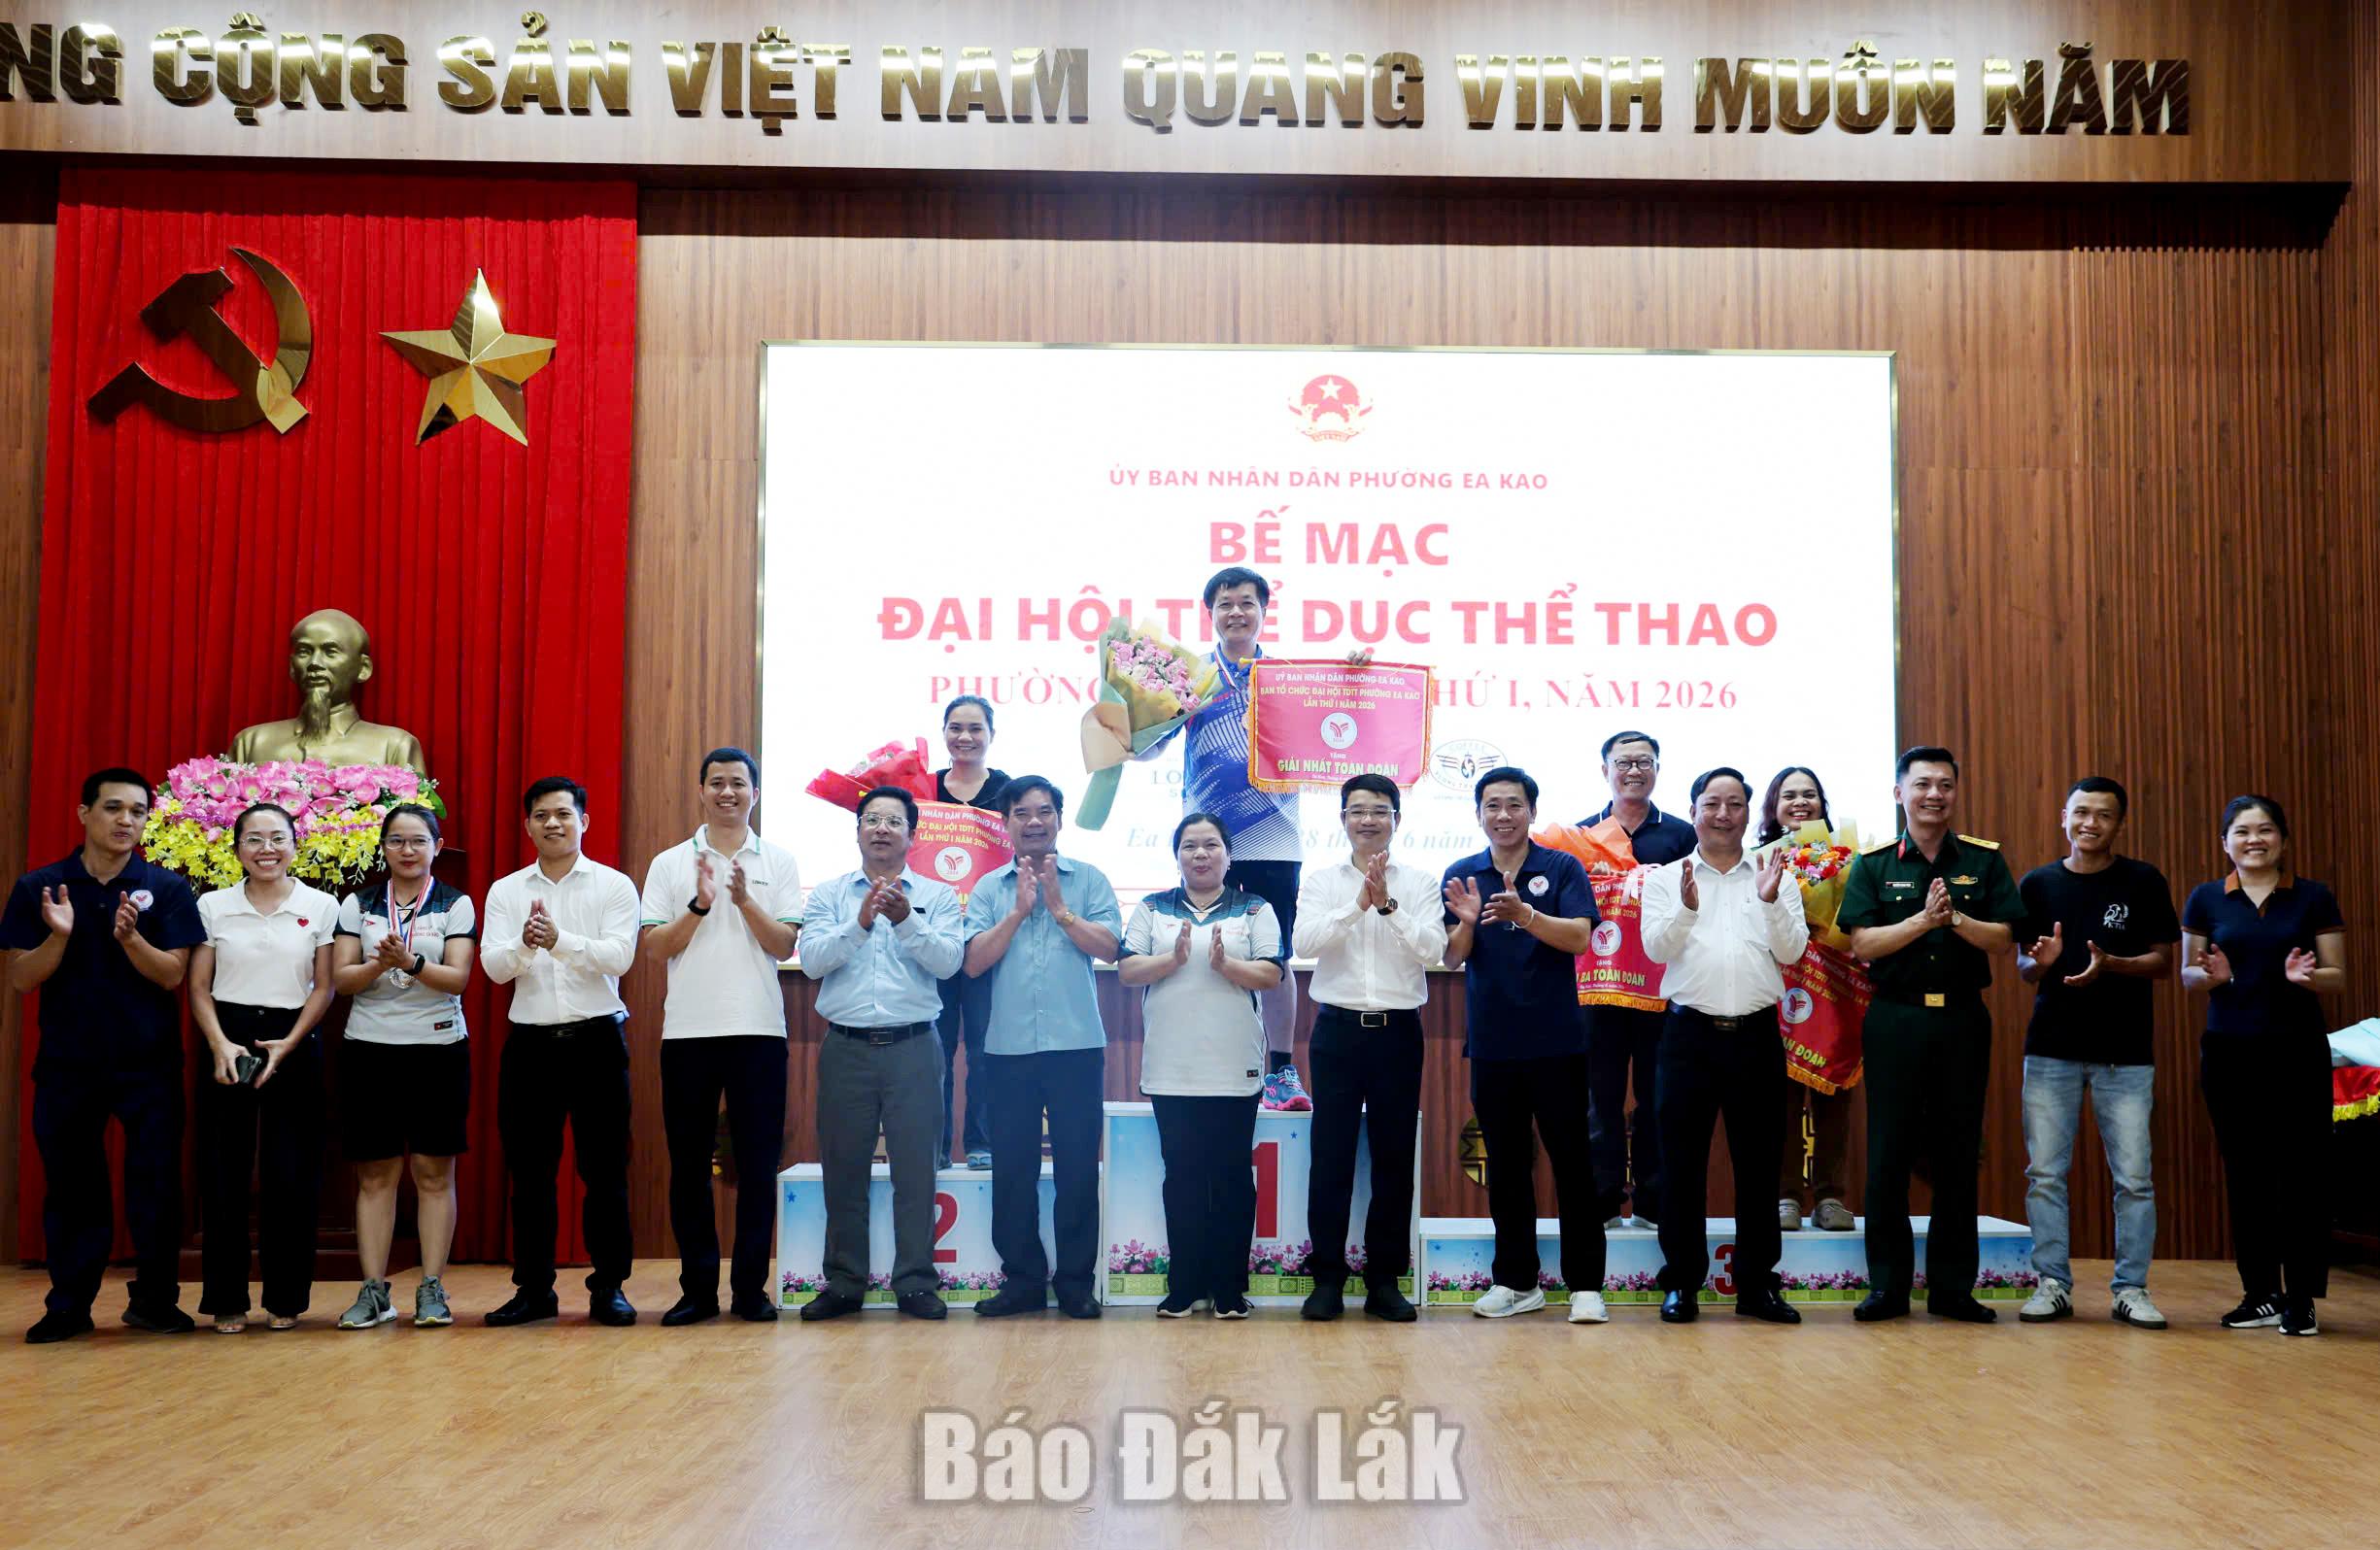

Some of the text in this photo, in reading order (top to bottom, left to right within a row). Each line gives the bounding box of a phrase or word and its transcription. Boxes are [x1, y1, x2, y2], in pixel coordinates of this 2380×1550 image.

[152, 12, 409, 126] CỘNG
[437, 11, 630, 115] SẢN
[662, 25, 851, 134] VIỆT
[881, 45, 1089, 123] NAM
[1122, 49, 1425, 134] QUANG
[1454, 54, 1663, 133] VINH
[1692, 39, 1956, 135] MUÔN
[1983, 42, 2192, 135] NĂM
[1109, 463, 1548, 490] ỦY BAN NHÂN DÂN PHƯỜNG EA KAO
[1209, 505, 1449, 578] BẾ MẠC
[877, 597, 993, 654] ĐẠI
[1018, 585, 1133, 655] HỘI
[1302, 599, 1431, 655] DỤC
[1451, 582, 1579, 645] THỂ
[1594, 602, 1779, 648] THAO
[1260, 686, 1275, 695] BAN
[1405, 691, 1420, 700] KAO
[1287, 673, 1302, 682] BAN
[1390, 677, 1405, 686] KAO
[1432, 670, 1497, 707] HỨ
[1546, 672, 1641, 708] NĂM
[1655, 680, 1737, 709] 2026
[1358, 700, 1376, 709] 2026
[1277, 756, 1300, 772] GIẢI
[1581, 971, 1591, 983] BA
[1250, 1141, 1278, 1238] 1
[933, 1192, 959, 1263] 2
